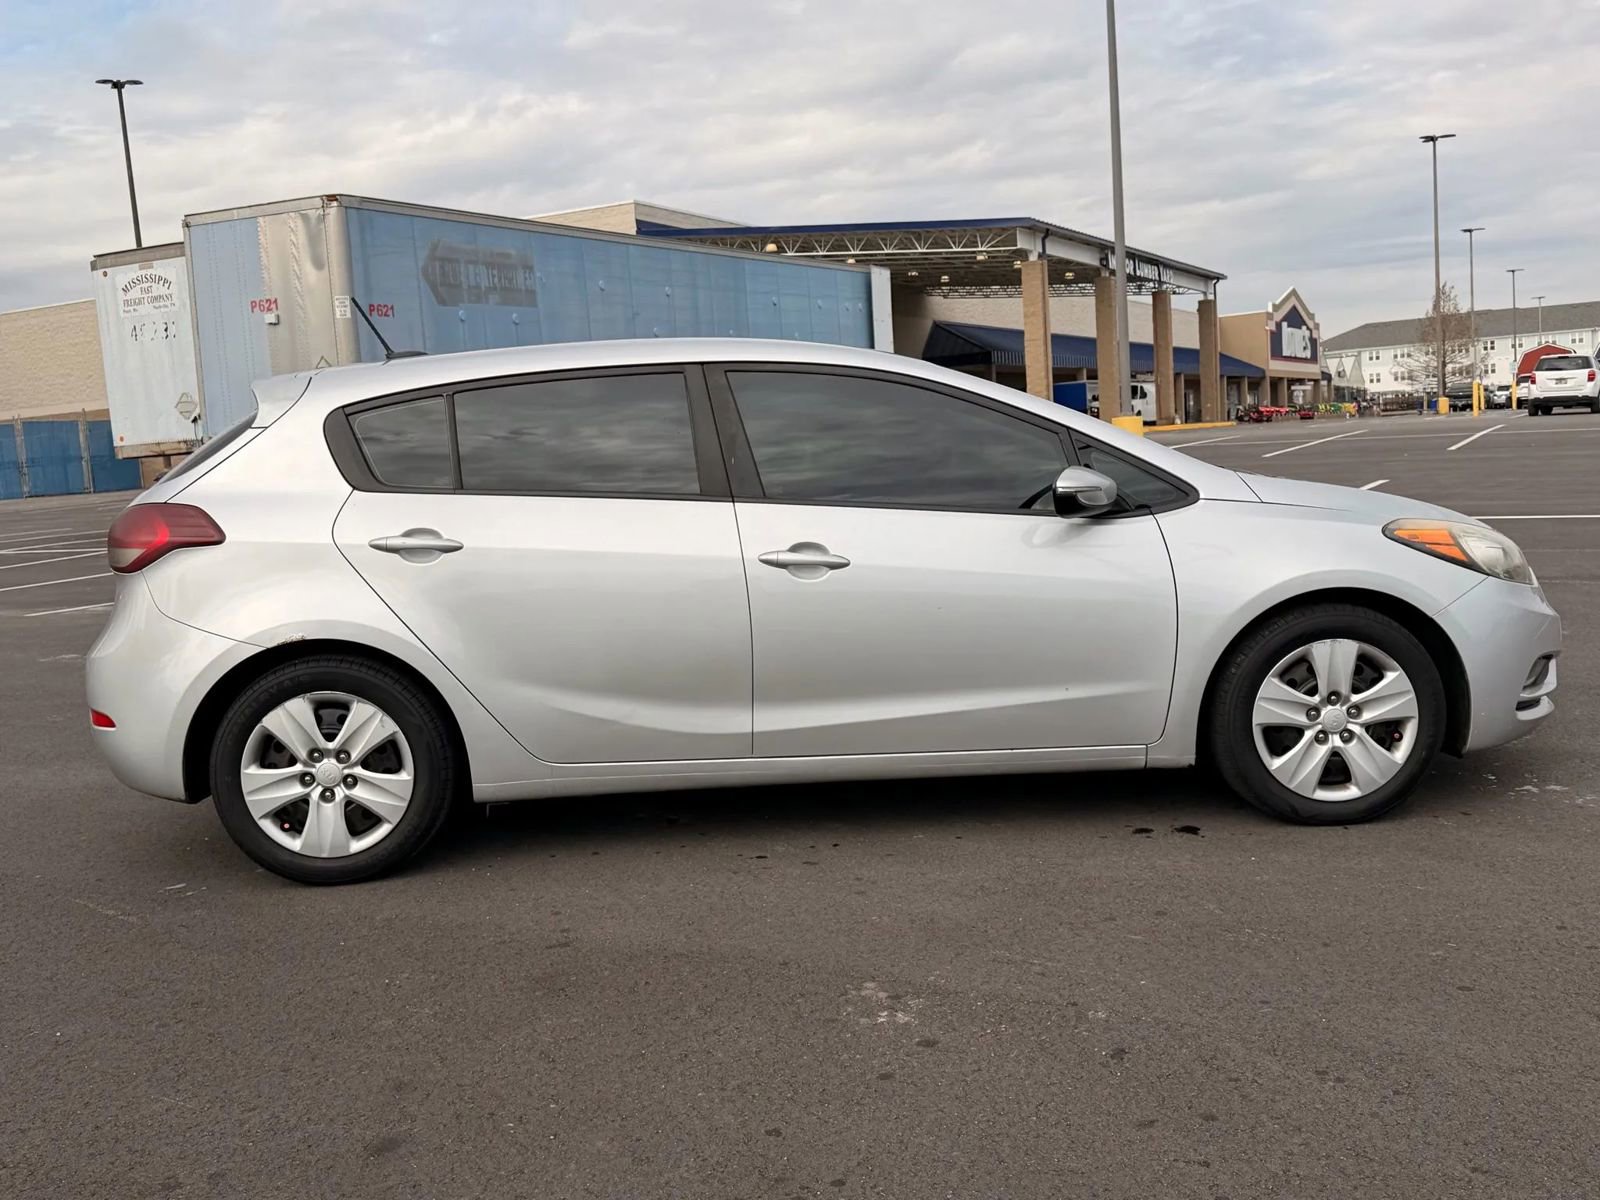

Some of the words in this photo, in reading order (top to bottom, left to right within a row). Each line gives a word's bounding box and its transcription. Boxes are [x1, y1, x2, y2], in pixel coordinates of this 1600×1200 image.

[121, 273, 172, 294] MISSISSIPPI
[123, 296, 146, 308] FREIGHT
[146, 293, 174, 305] COMPANY
[250, 298, 279, 313] P621
[368, 303, 395, 317] P621
